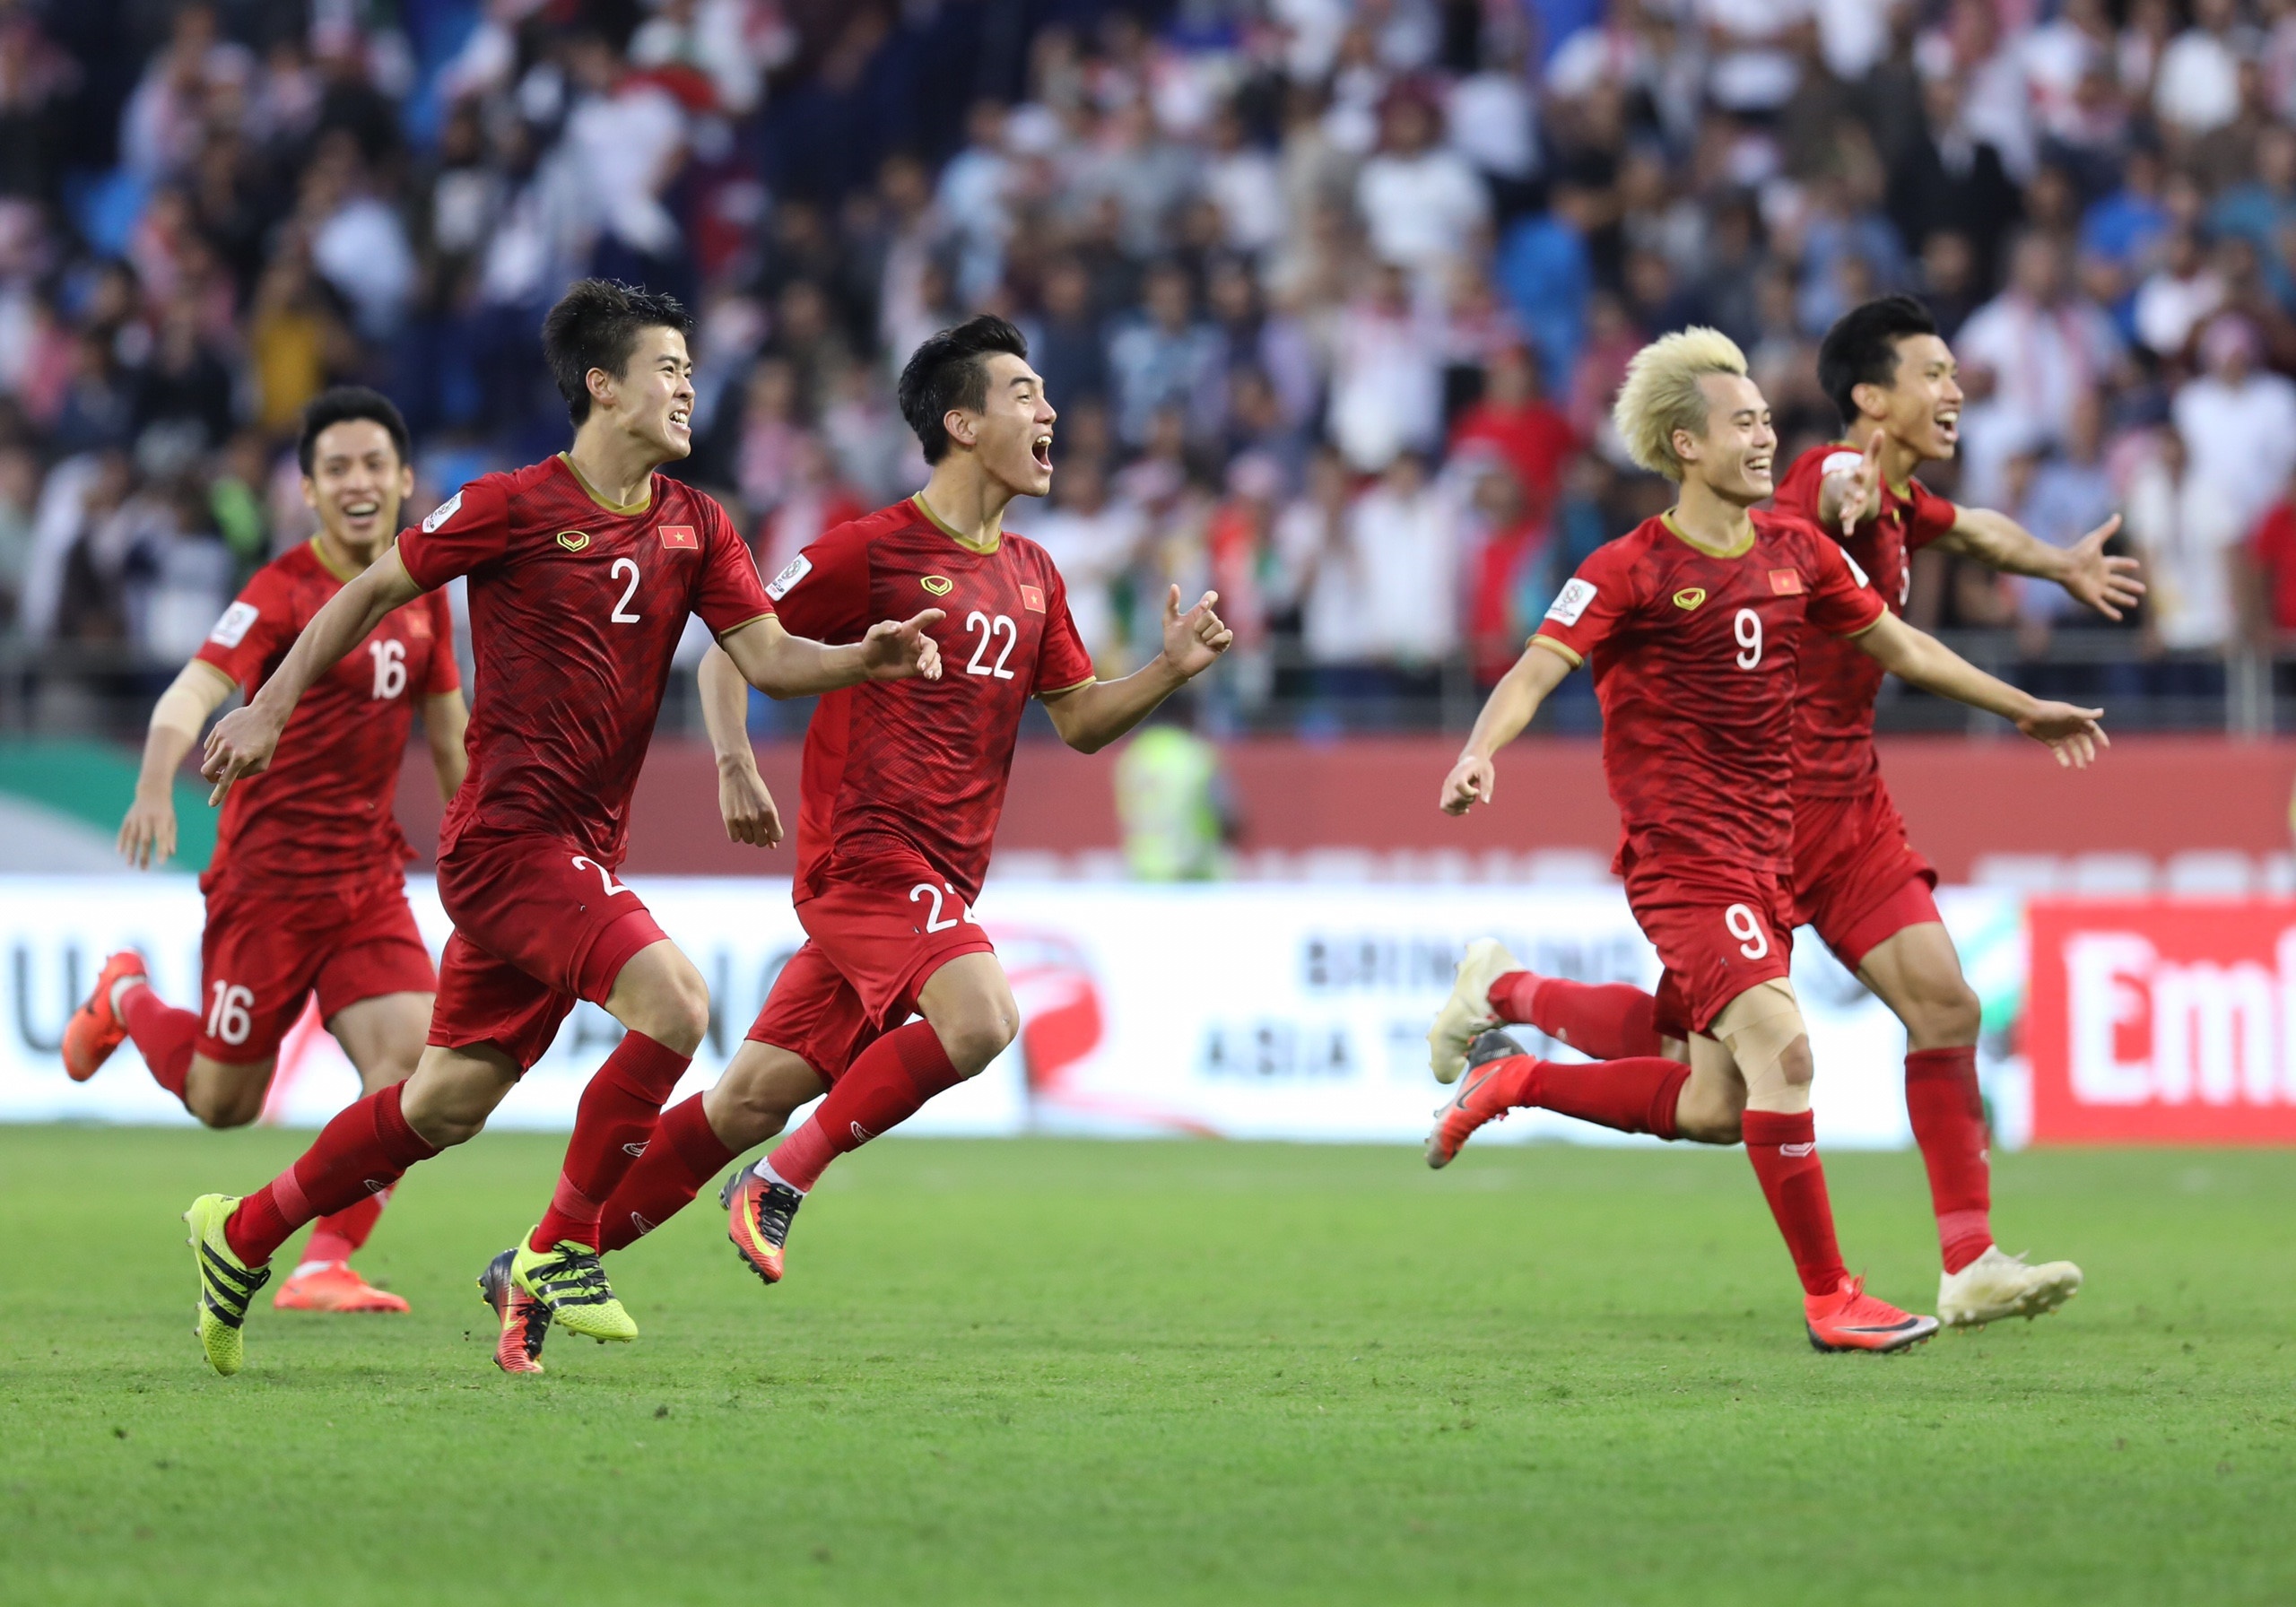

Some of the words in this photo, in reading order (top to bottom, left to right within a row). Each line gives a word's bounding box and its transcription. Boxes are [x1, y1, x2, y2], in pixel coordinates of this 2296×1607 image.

[611, 557, 641, 624] 2
[369, 638, 407, 699] 16
[966, 610, 1018, 681] 22
[1734, 608, 1763, 671] 9
[571, 855, 628, 897] 2
[1725, 902, 1770, 960] 9
[207, 979, 254, 1045] 16
